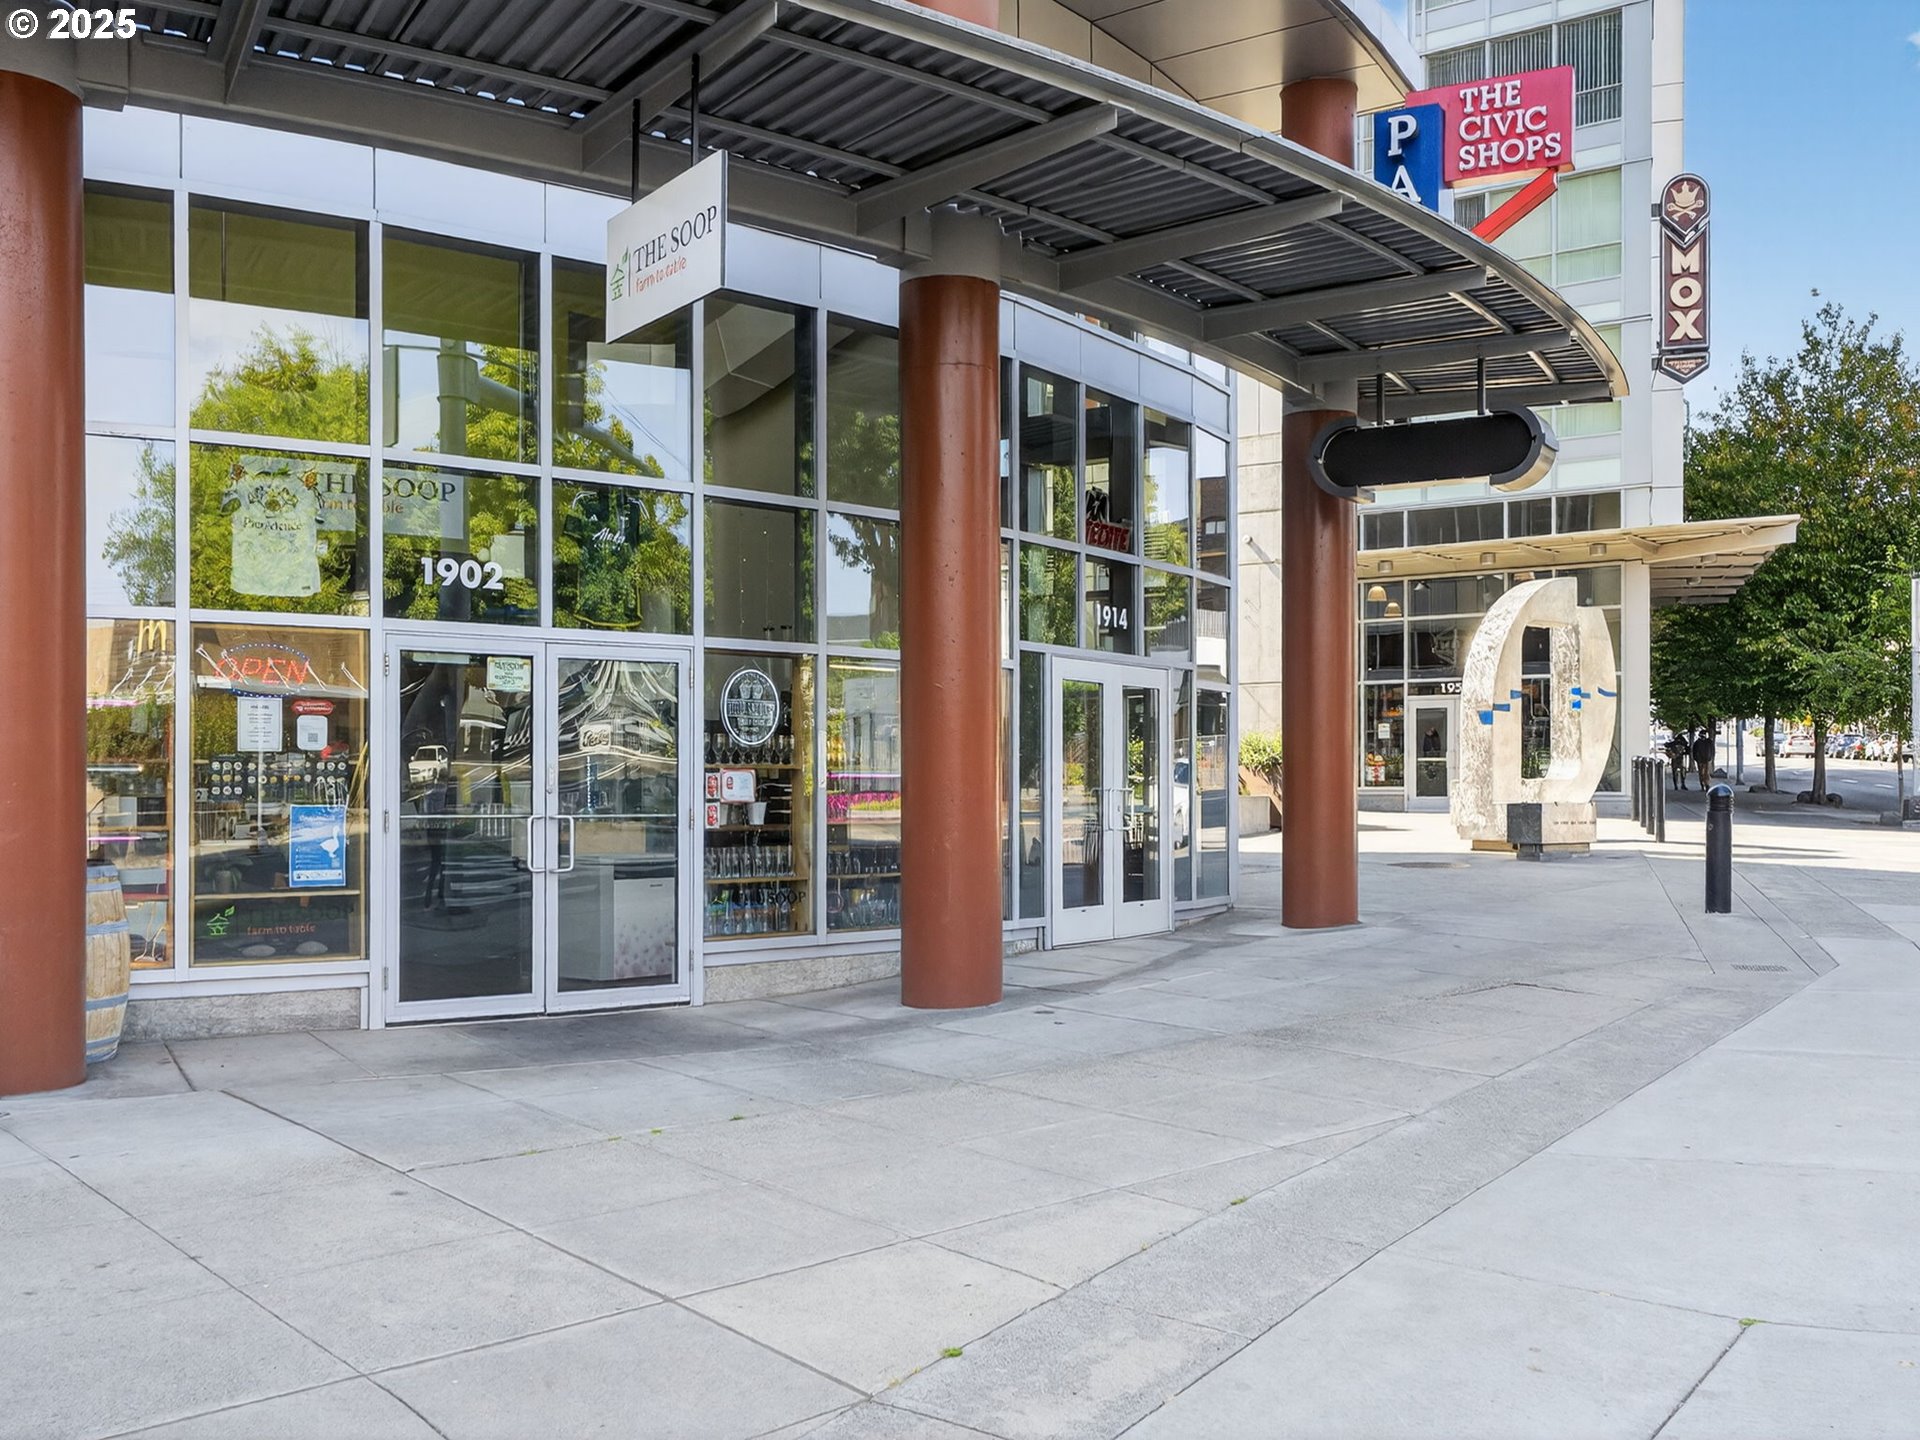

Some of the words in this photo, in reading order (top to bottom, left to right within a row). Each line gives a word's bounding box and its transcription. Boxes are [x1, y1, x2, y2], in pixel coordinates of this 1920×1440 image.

[1459, 80, 1522, 114] THE
[1459, 105, 1548, 141] CIVIC
[1459, 132, 1562, 171] SHOPS
[633, 233, 667, 273] THE
[670, 205, 717, 253] SOOP
[1669, 244, 1704, 342] MOX
[421, 556, 504, 590] 1902
[1096, 604, 1129, 631] 1914
[213, 656, 309, 685] OPEN
